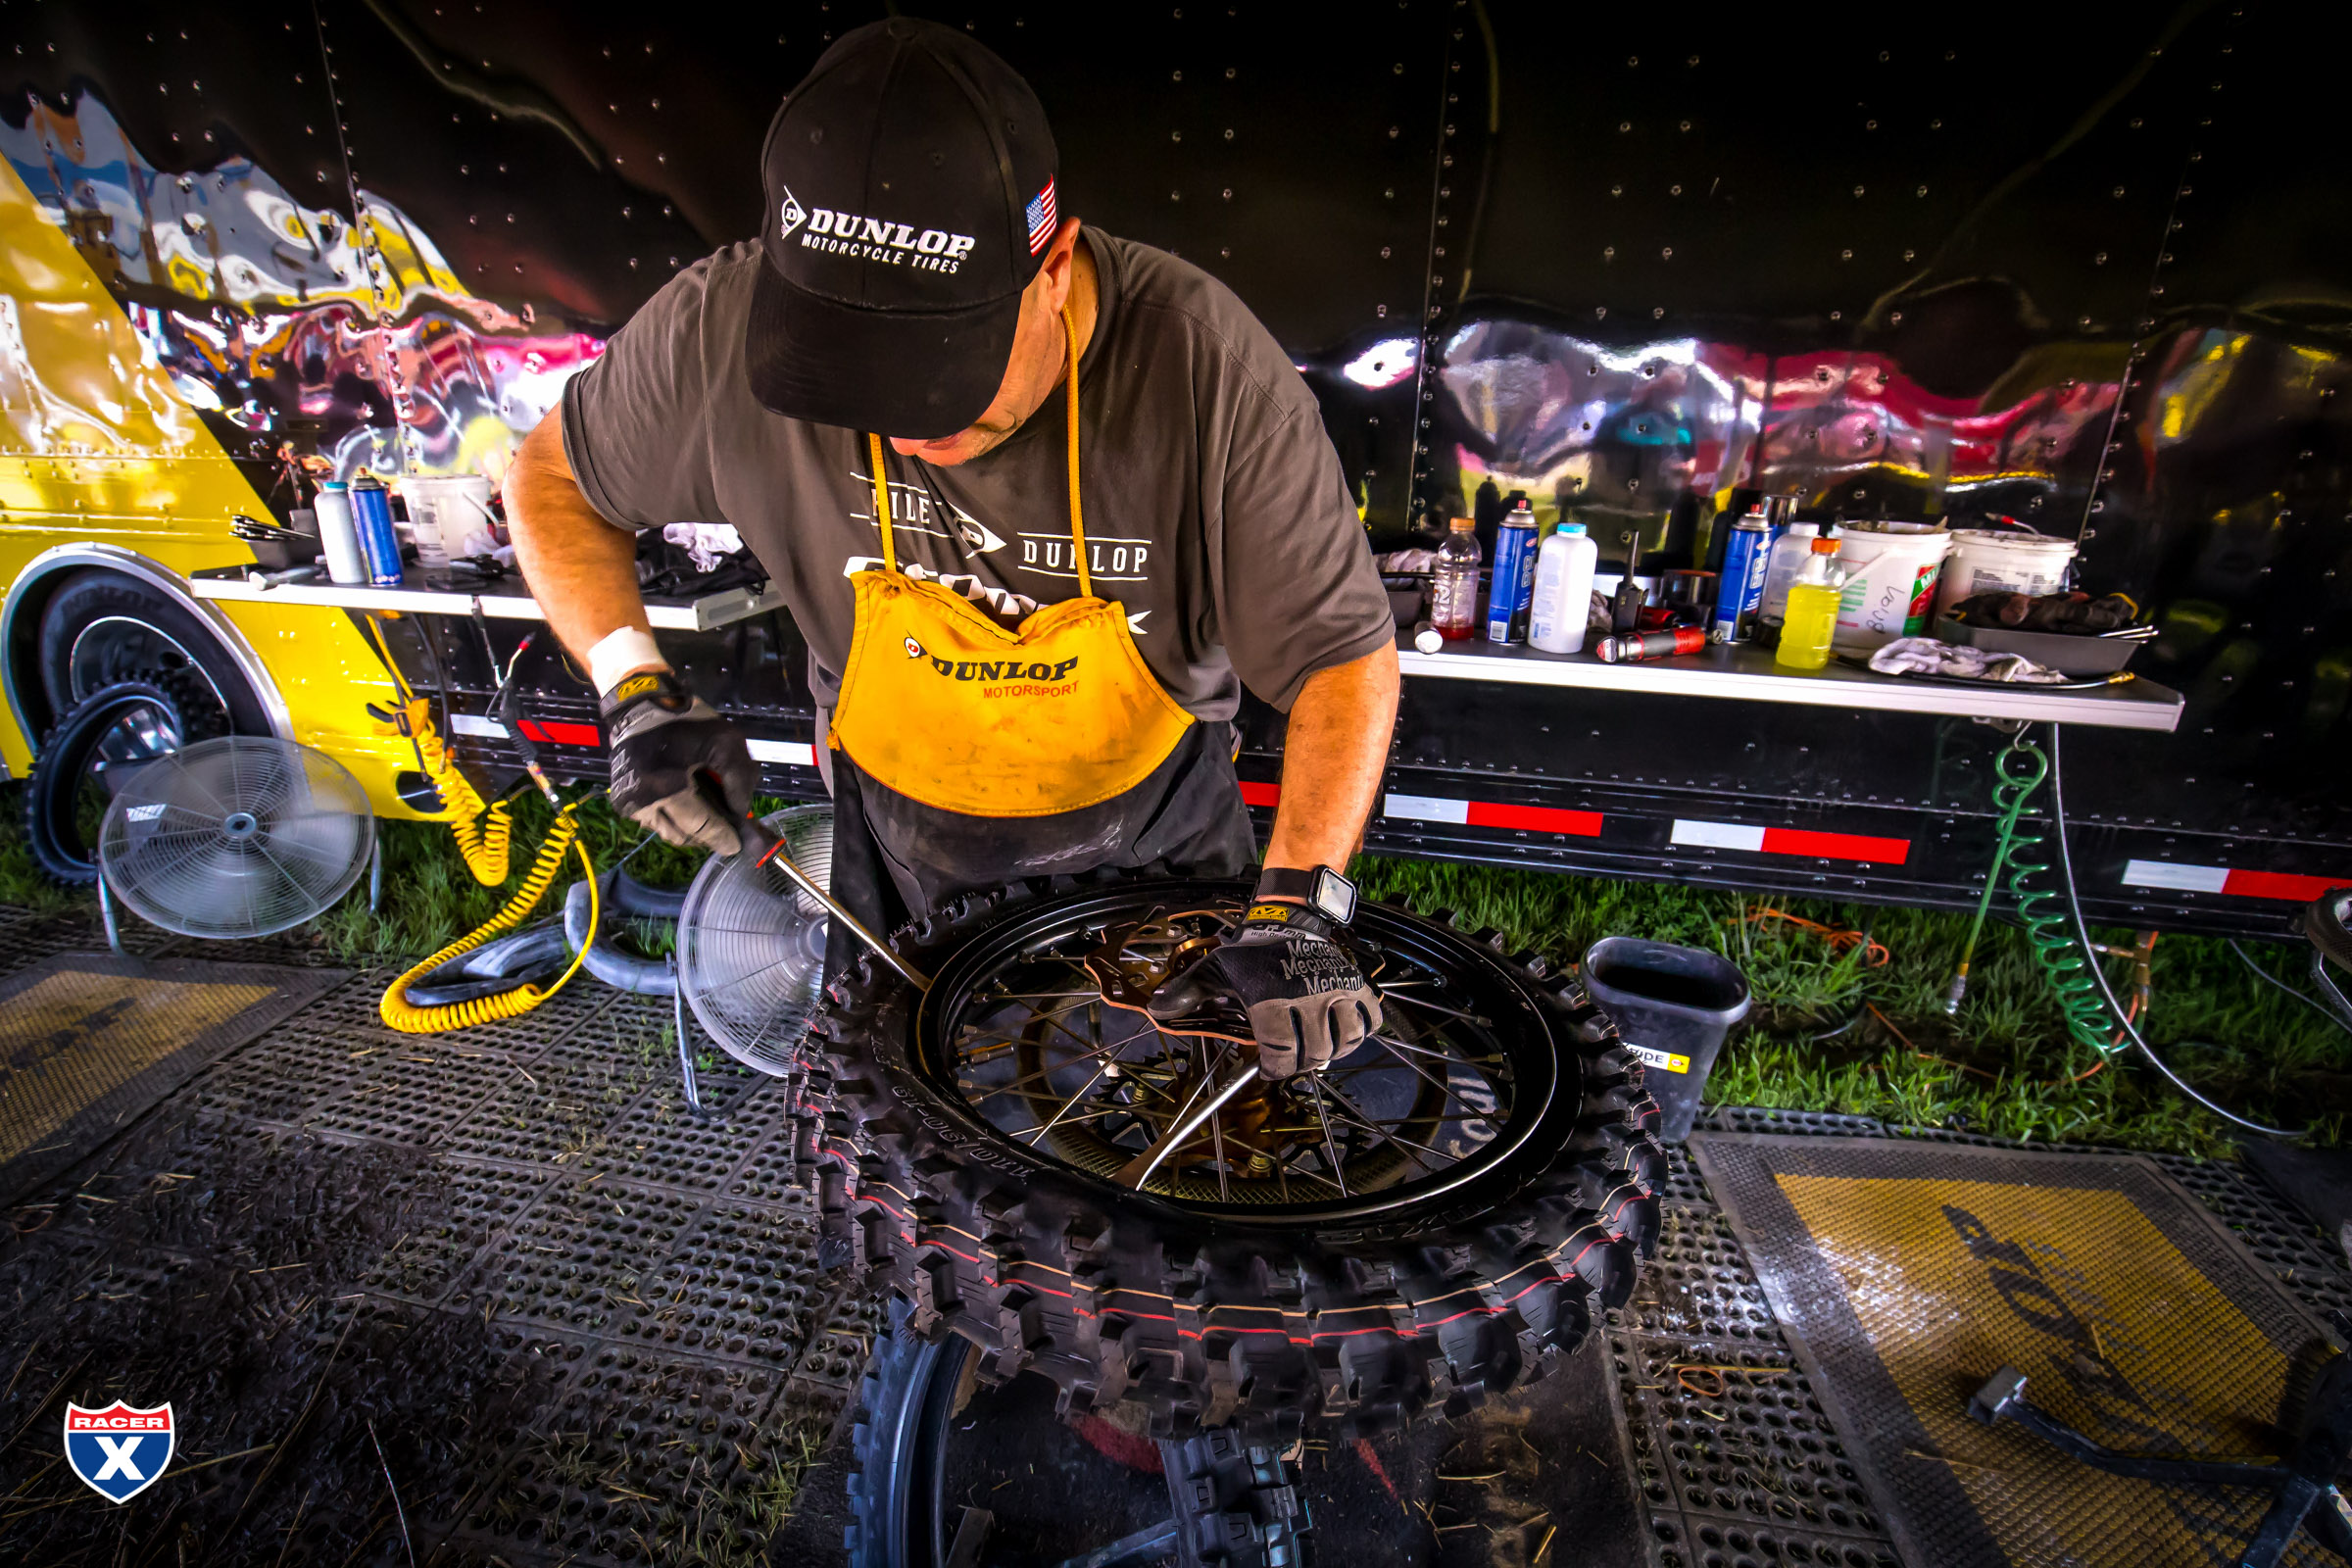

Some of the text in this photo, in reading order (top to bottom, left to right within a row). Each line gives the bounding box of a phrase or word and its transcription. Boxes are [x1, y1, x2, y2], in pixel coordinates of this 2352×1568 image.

[802, 233, 959, 273] MOTORCYCLE TIRES
[808, 208, 975, 258] DUNLOP
[1866, 585, 1905, 634] Brian
[931, 656, 1078, 683] DUNLOP
[983, 681, 1079, 699] MOTORSPORT
